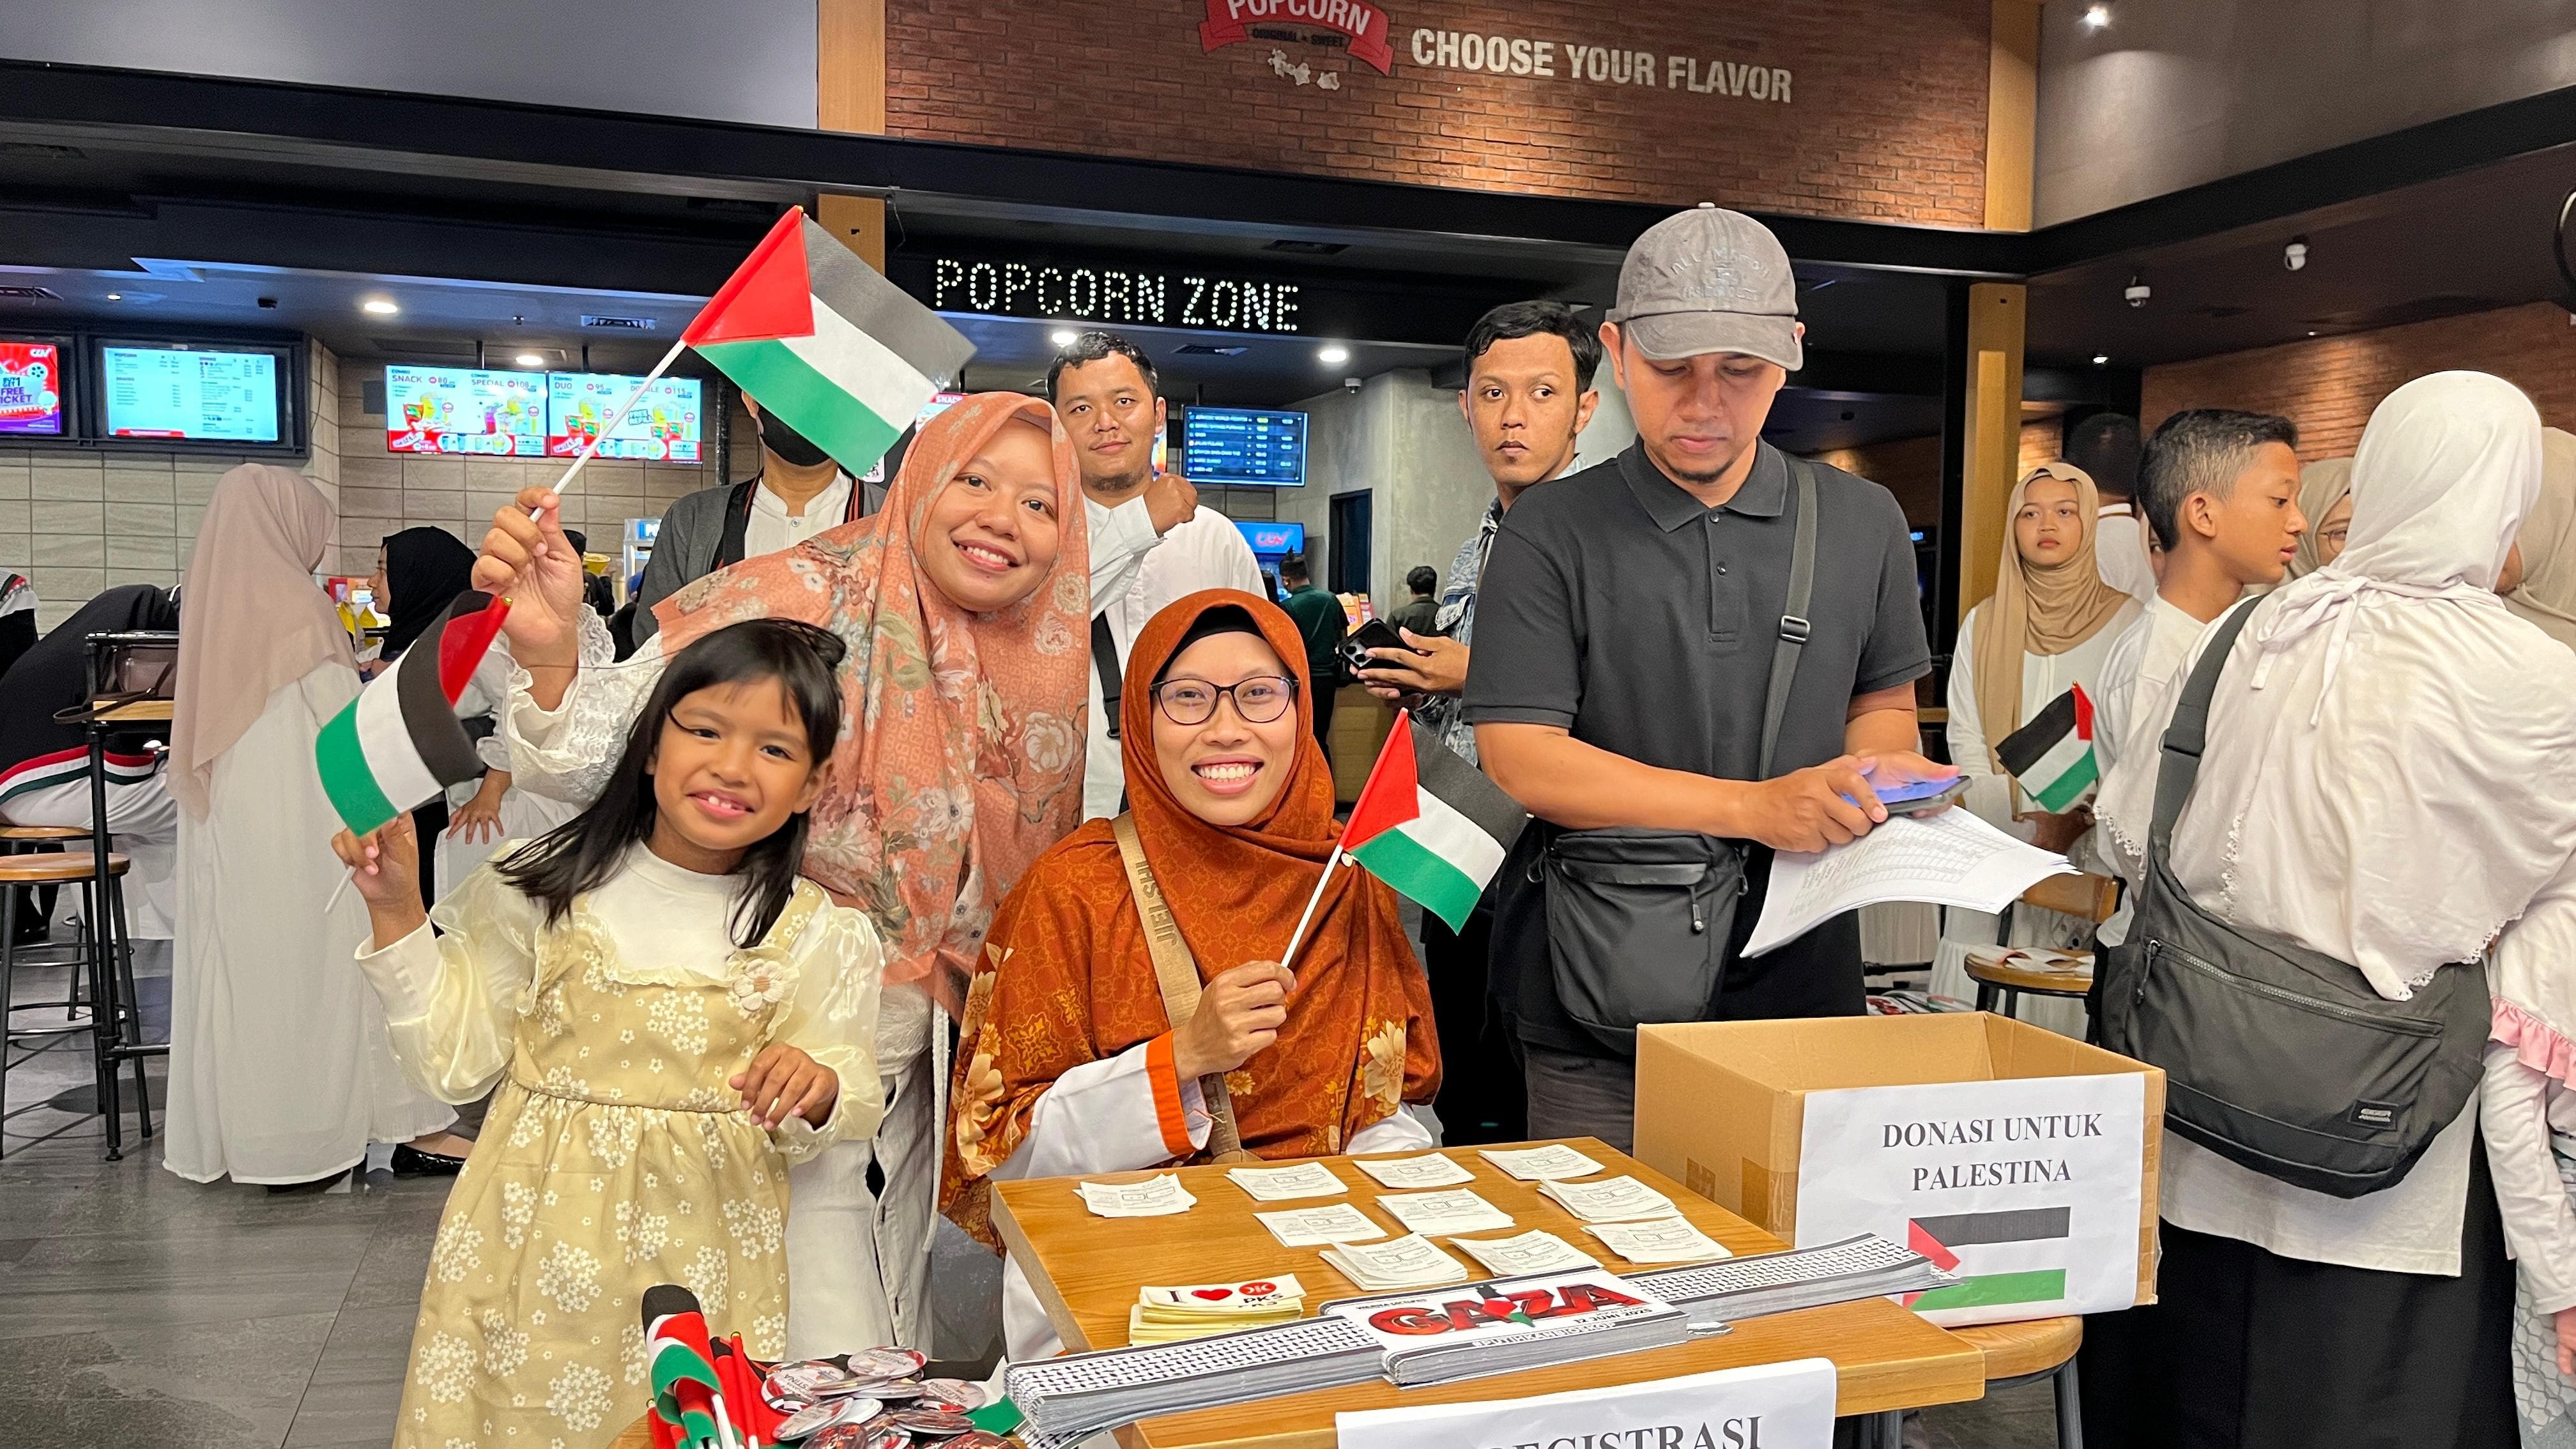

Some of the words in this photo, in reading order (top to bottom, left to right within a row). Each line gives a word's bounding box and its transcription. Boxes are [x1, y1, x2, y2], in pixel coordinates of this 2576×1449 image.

[1227, 0, 1371, 35] POPCORN
[1411, 28, 1554, 77] CHOOSE
[1564, 43, 1656, 86] YOUR
[1667, 56, 1791, 103] FLAVOR
[936, 259, 1165, 323] POPCORN
[1182, 277, 1298, 331] ZONE
[0, 395, 32, 404] ICKET
[1, 387, 24, 395] FREE
[1882, 1119, 1994, 1148] DONASI
[2005, 1113, 2103, 1141] UNTUK
[1912, 1159, 2072, 1191] PALESTINA
[1167, 1291, 1187, 1304] I
[1243, 1293, 1283, 1304] PKS
[1368, 1283, 1648, 1335] GAZA
